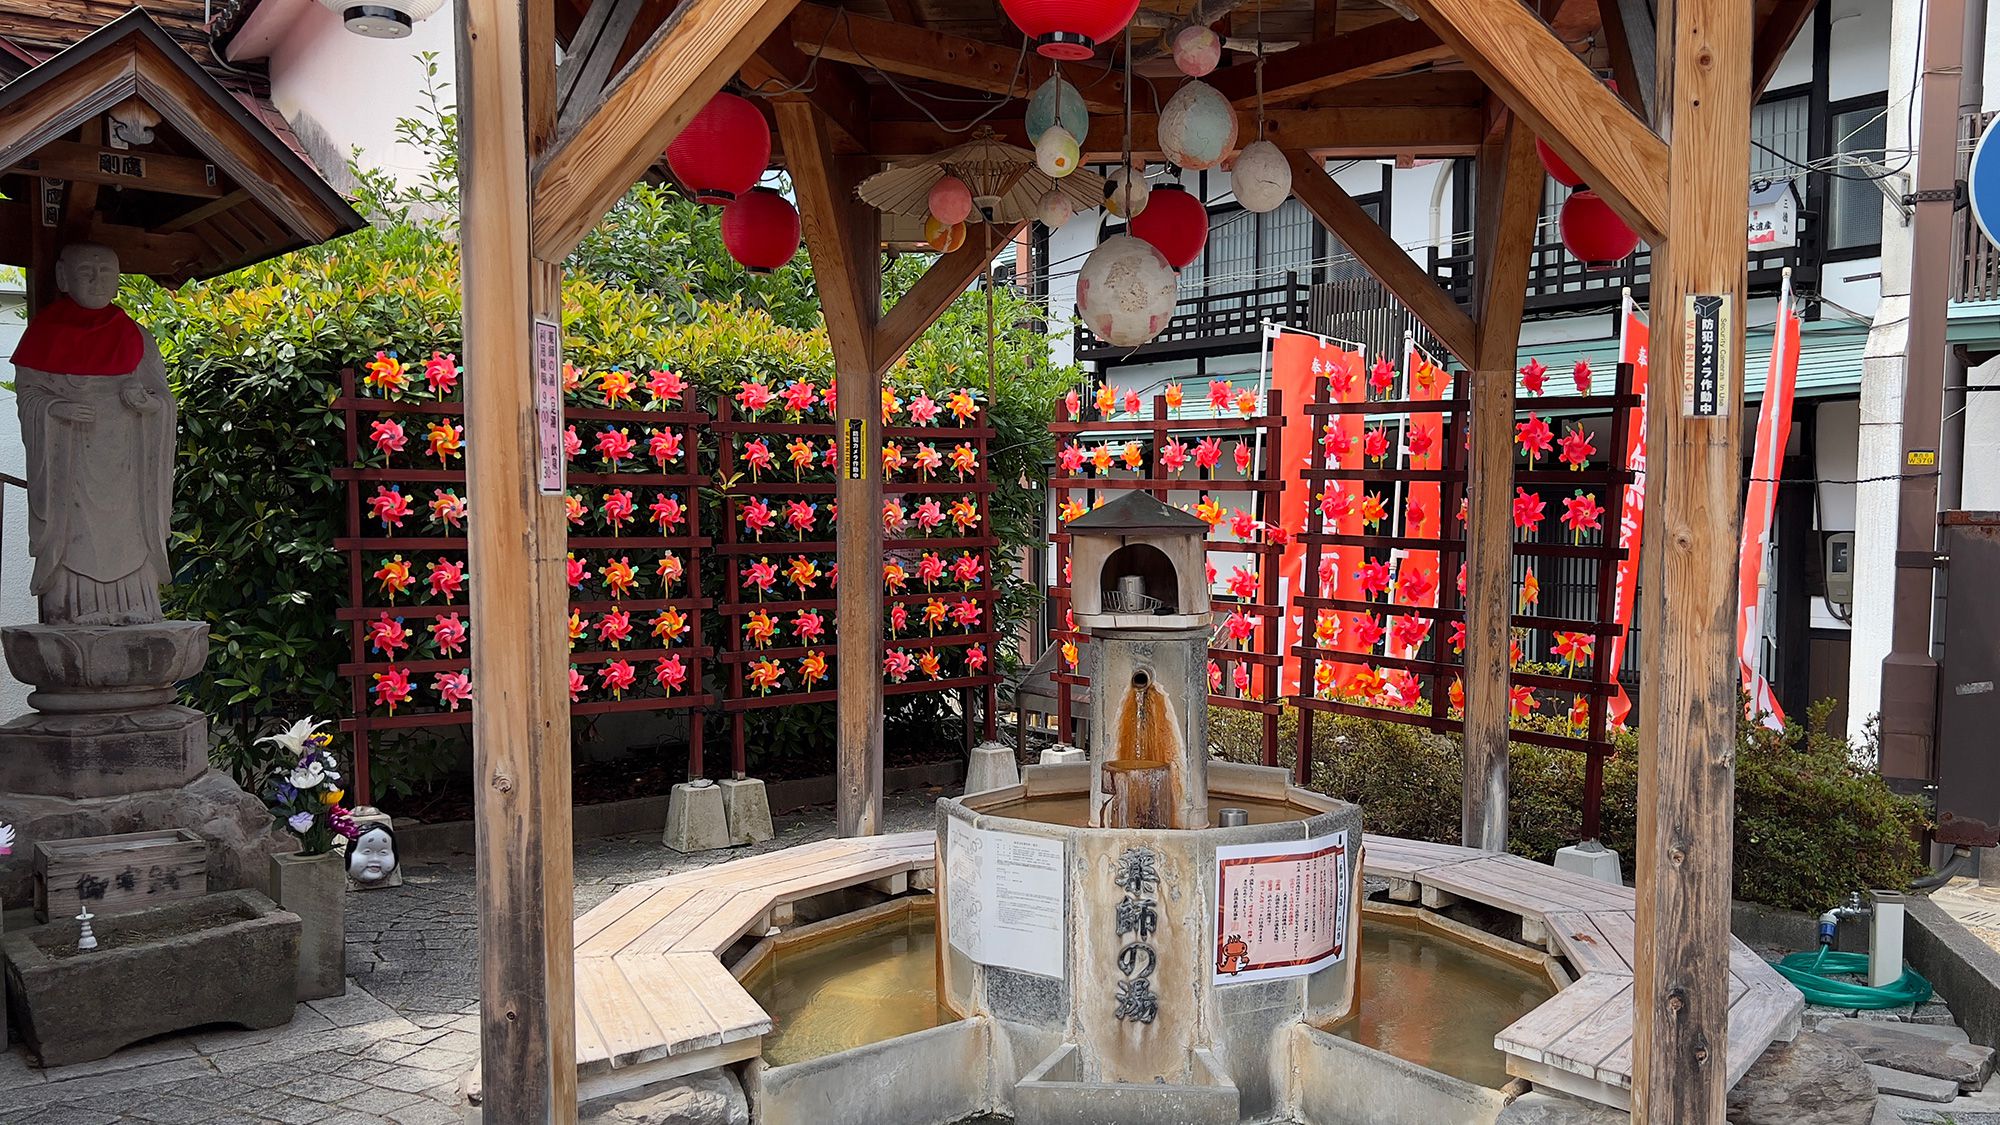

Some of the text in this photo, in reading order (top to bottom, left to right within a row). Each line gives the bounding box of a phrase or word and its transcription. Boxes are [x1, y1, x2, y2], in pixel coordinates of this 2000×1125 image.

[1749, 220, 1773, 232] 本遺産
[1720, 318, 1728, 348] Security
[1685, 319, 1695, 403] WARNING!!
[1700, 318, 1714, 415] 防犯カメラ作動中
[1719, 350, 1727, 381] Cameras
